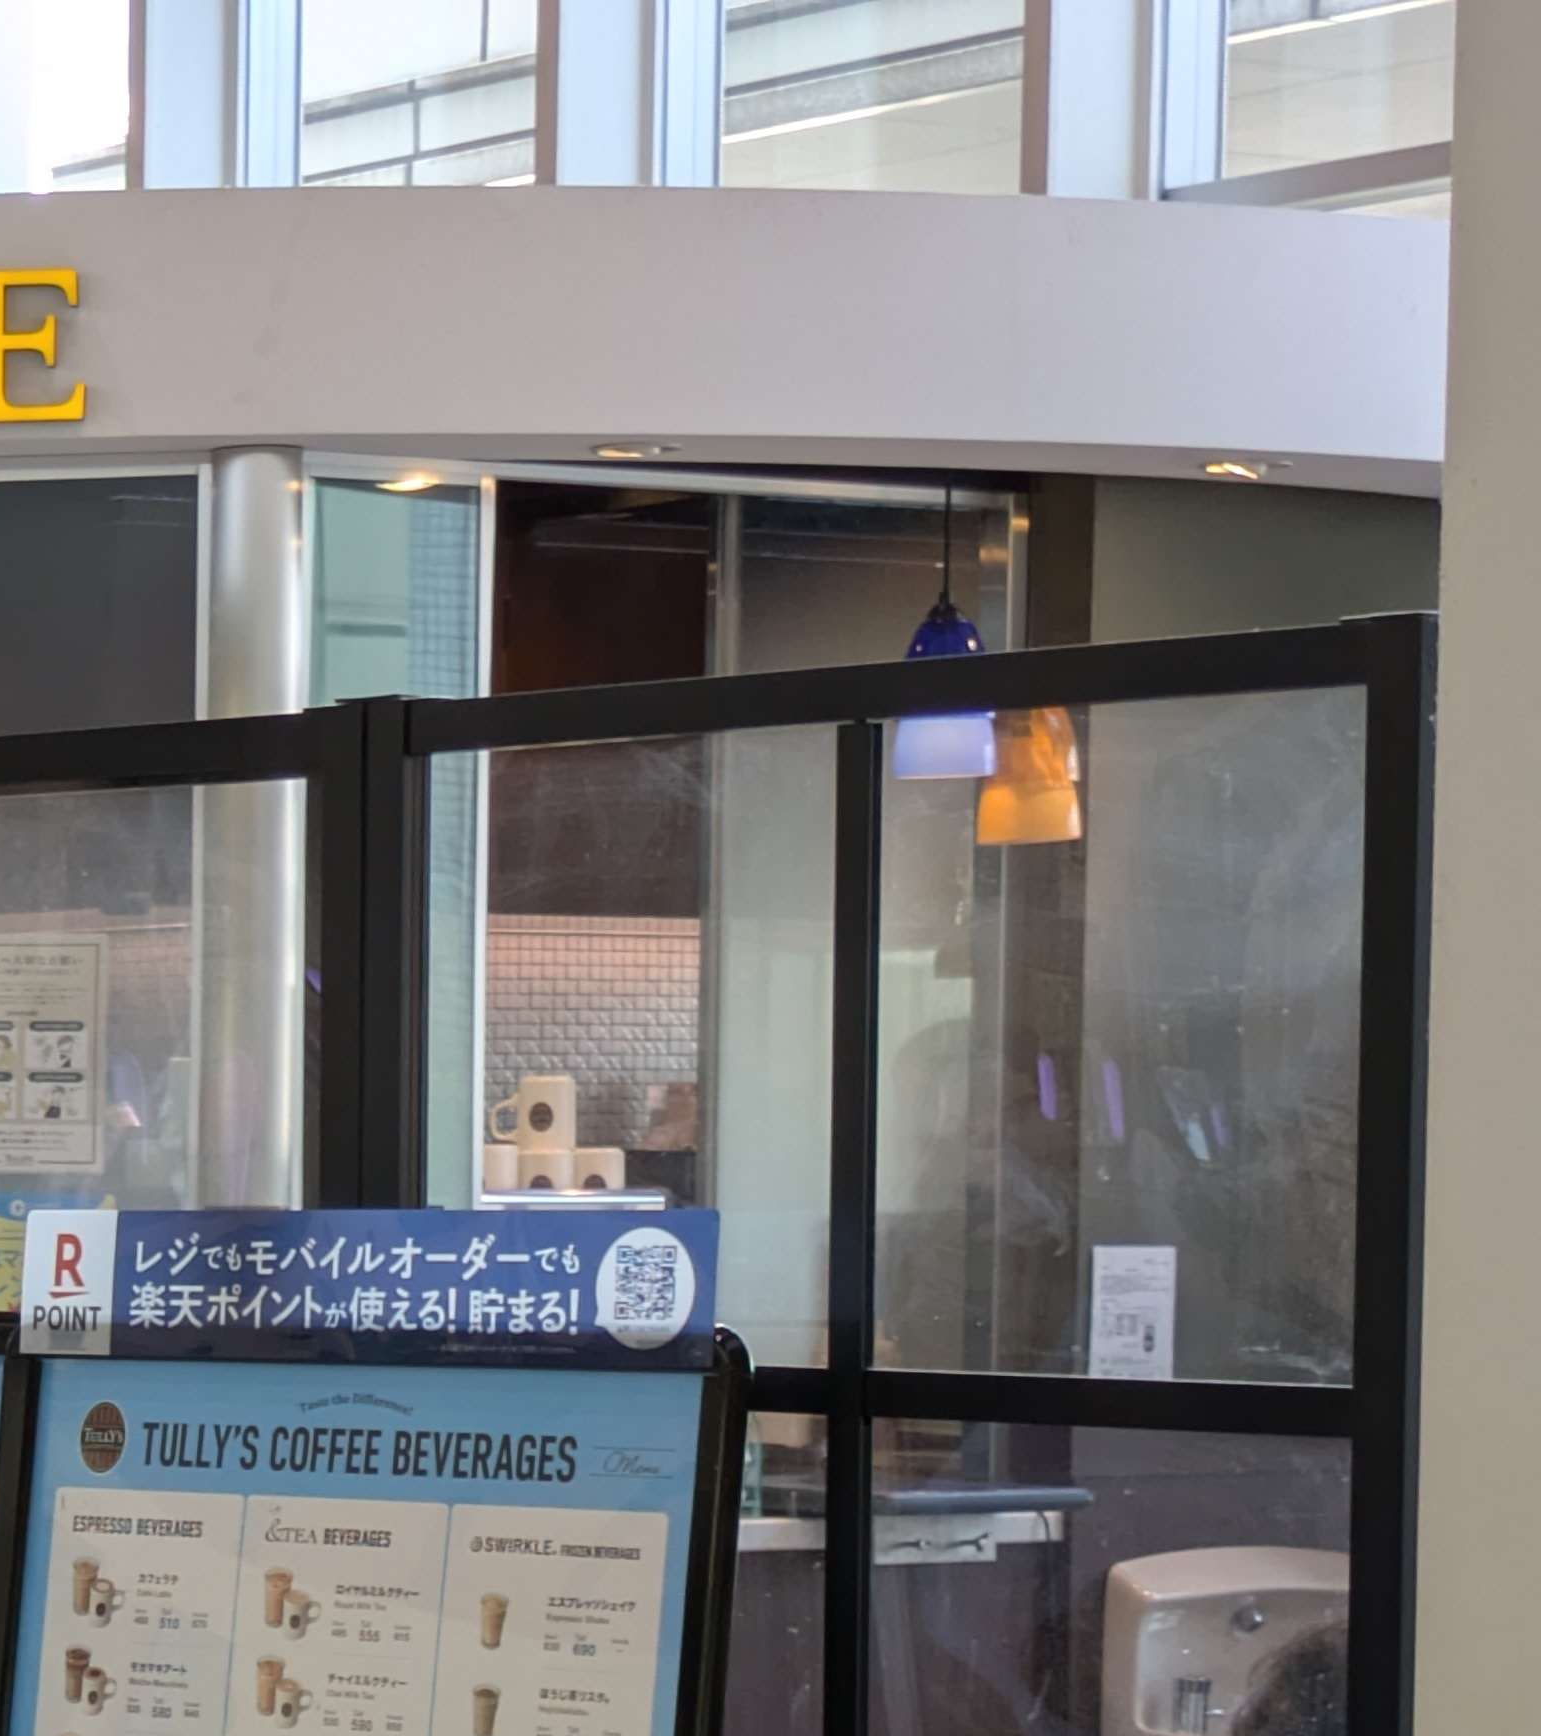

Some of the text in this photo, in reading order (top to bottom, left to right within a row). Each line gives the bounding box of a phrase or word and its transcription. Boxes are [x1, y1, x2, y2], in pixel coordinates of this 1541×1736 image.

[53, 1233, 85, 1288] R
[134, 1232, 582, 1276] レジでもモバイルオーダーでも
[33, 1306, 103, 1333] POINT
[142, 1421, 578, 1483] TULLY'S COFFEE BEVERAGES
[72, 1515, 203, 1538] ESPRESSO BEVERAGES
[322, 1528, 391, 1548] BEVERAGES
